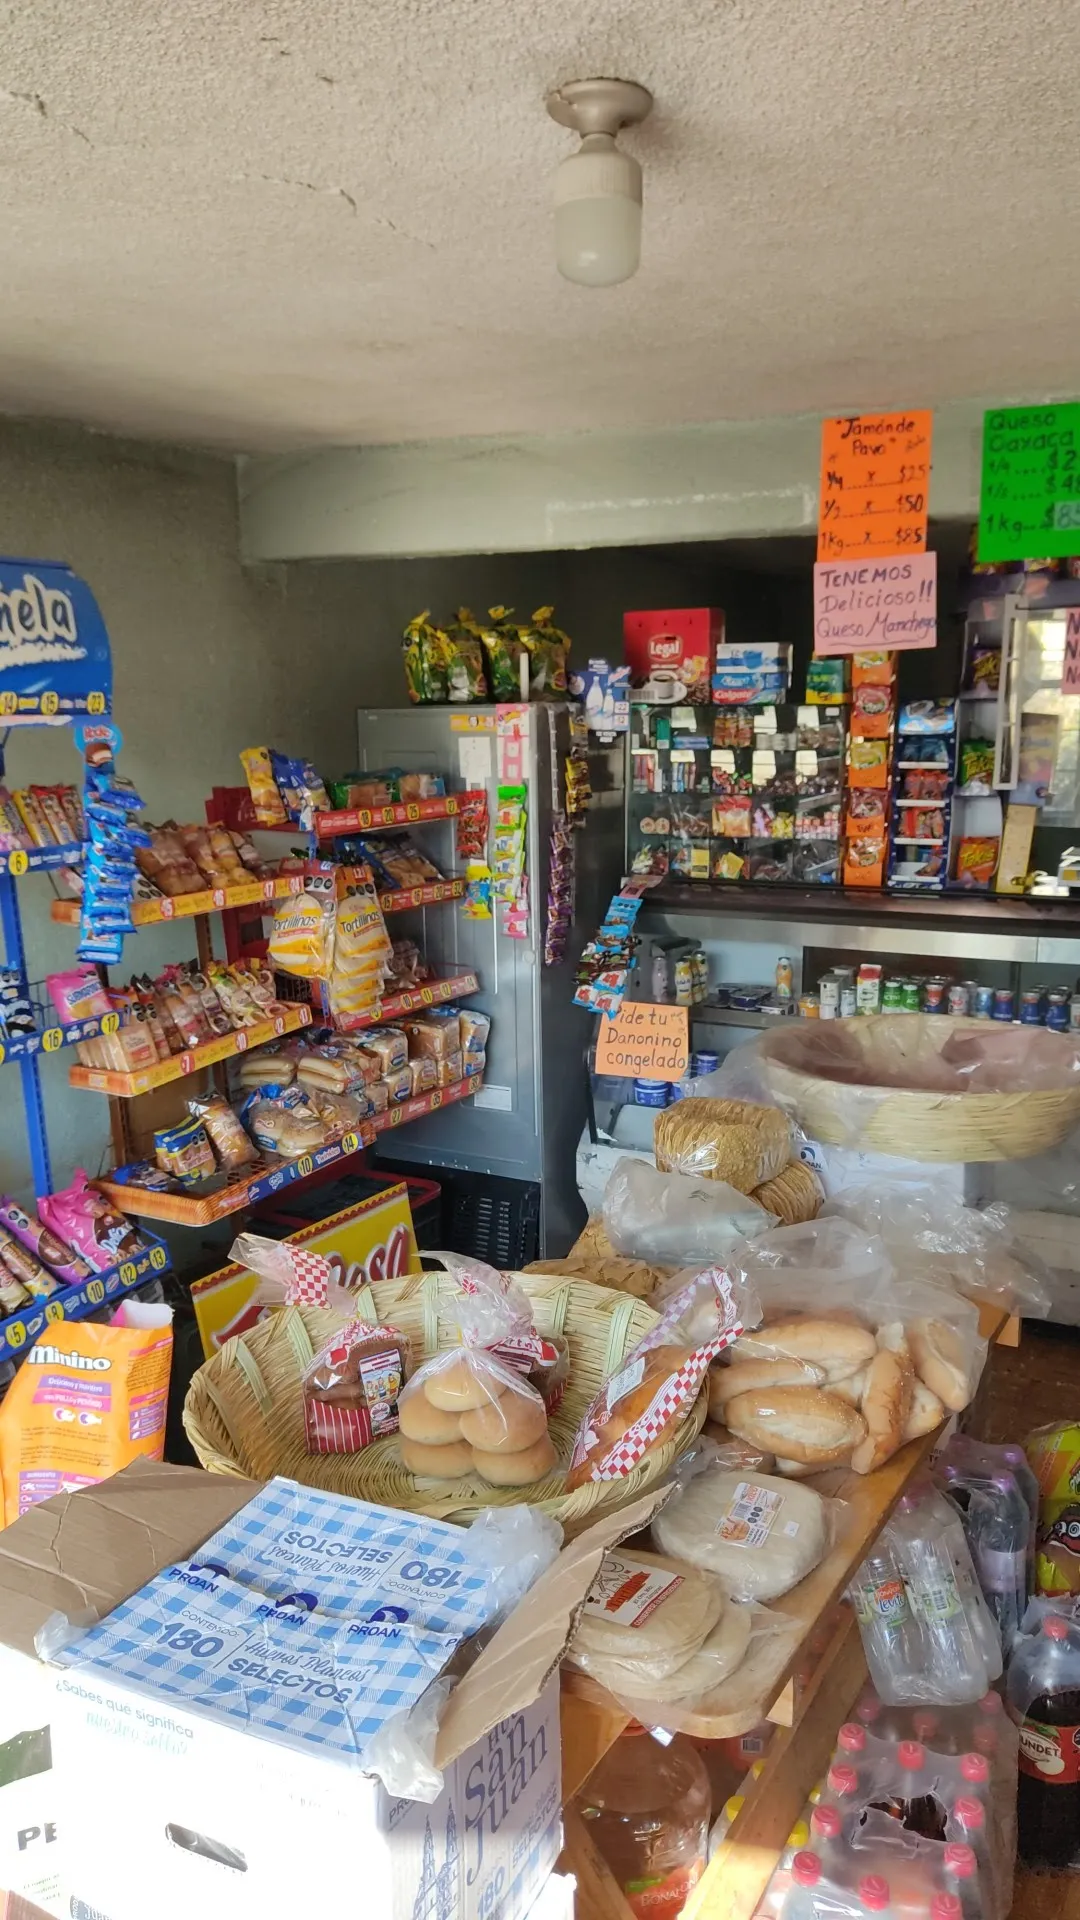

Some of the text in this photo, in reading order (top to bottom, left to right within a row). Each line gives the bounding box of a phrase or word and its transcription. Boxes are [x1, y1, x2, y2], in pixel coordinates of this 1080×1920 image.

[989, 411, 1056, 431] Queso
[819, 564, 912, 589] TENEMOS
[816, 616, 865, 639] Queso
[649, 640, 681, 658] Legal
[340, 911, 381, 933] Tortillinas
[648, 1007, 668, 1026] tu
[605, 1026, 682, 1048] Danonino
[606, 1048, 686, 1075] congelado
[283, 1530, 394, 1565] SELECTOS
[326, 1562, 381, 1588] Huevos
[399, 1560, 463, 1590] 180
[167, 1567, 401, 1639] PROAN PROAN PROAN
[156, 1622, 225, 1659] 180
[244, 1640, 371, 1684] Huevos Blancos
[227, 1657, 354, 1704] SELECTOS
[55, 1678, 194, 1739] ¿Sabes que significa
[1020, 1737, 1059, 1758] UNDET
[465, 1715, 528, 1832] San
[466, 1725, 548, 1887] Juan
